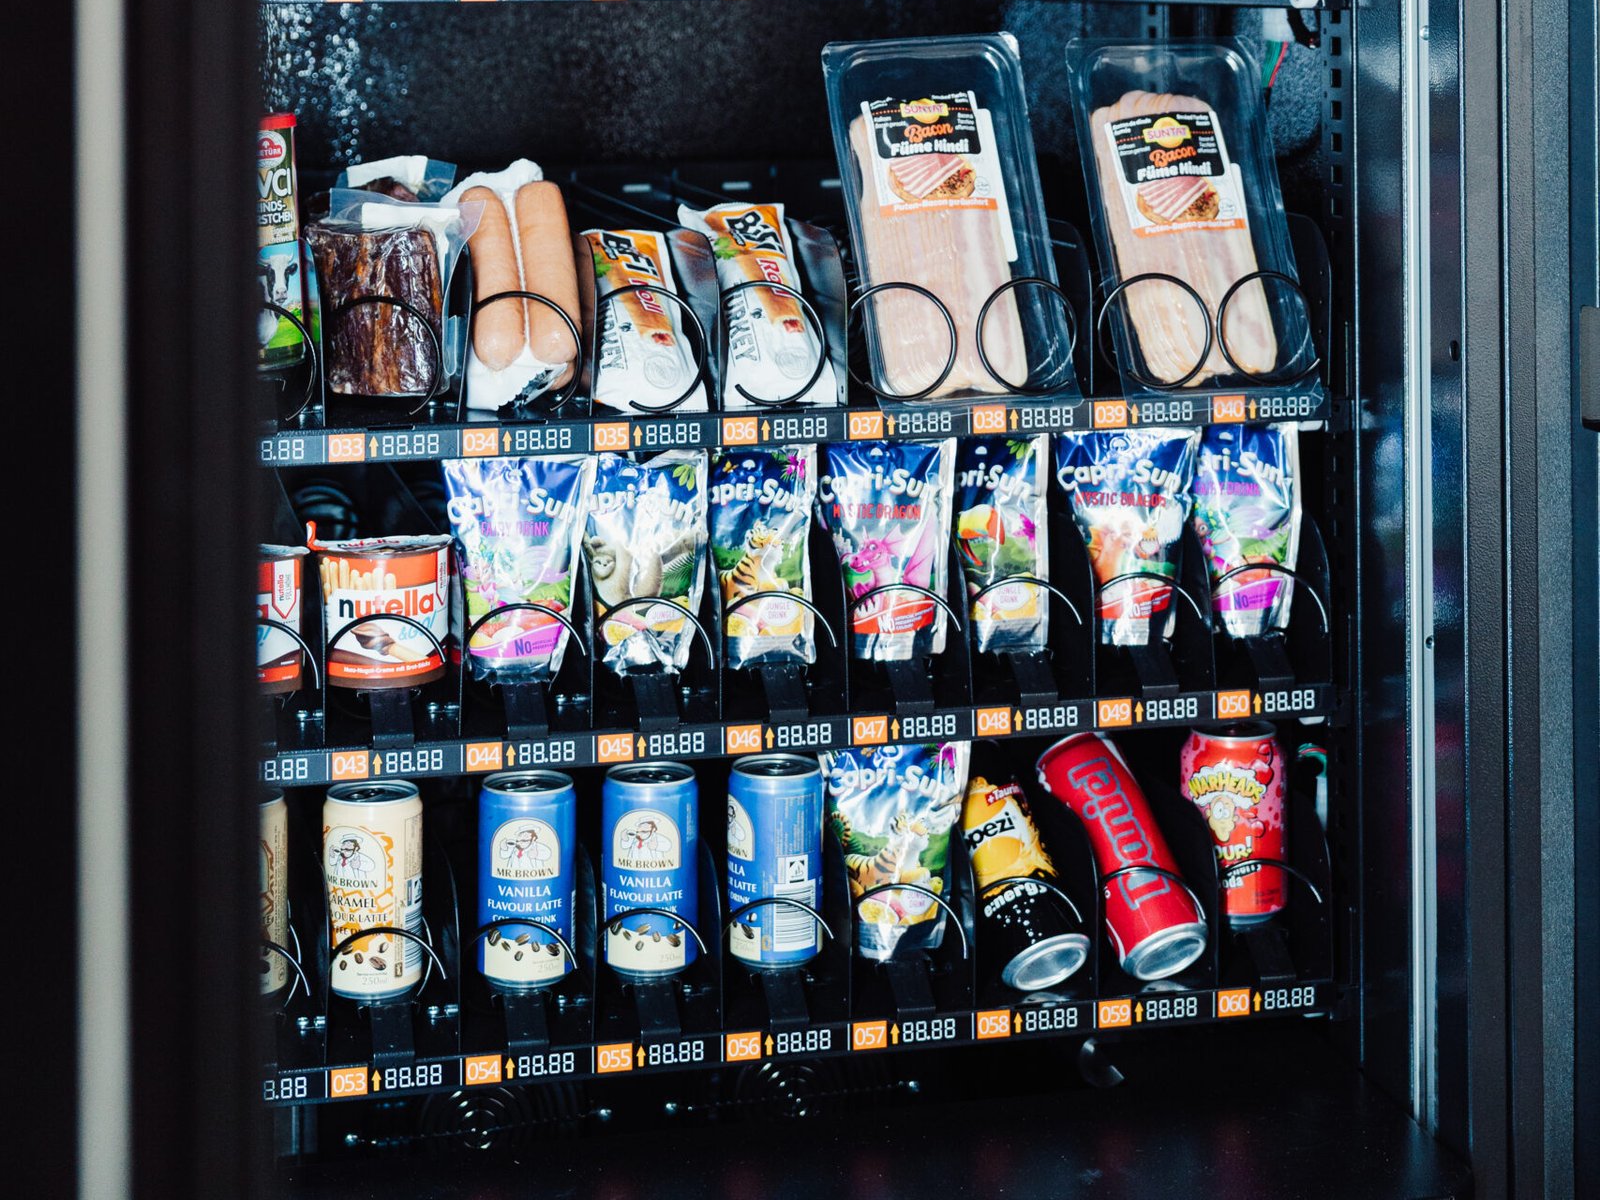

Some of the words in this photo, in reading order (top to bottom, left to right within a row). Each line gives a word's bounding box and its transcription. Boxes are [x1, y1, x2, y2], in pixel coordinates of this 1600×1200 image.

[904, 123, 954, 143] Bacon
[891, 142, 932, 156] Füme
[934, 139, 969, 153] Hindi
[1149, 146, 1197, 168] Bacon
[1137, 165, 1178, 181] Füme
[1179, 161, 1212, 175] Hindi
[974, 409, 1005, 429] 038
[1021, 407, 1073, 428] 88.88
[1095, 405, 1126, 423] 039
[1141, 402, 1193, 422] 88.88
[1212, 400, 1245, 418] 040
[1259, 397, 1310, 416] 88.88
[595, 427, 628, 446] 035
[646, 423, 700, 445] 88.88
[723, 422, 756, 440] 036
[774, 417, 827, 439] 88.88
[850, 416, 881, 435] 037
[899, 413, 952, 434] 88.88
[329, 436, 364, 458] 033
[383, 434, 439, 456] 88.88
[463, 432, 497, 451] 034
[516, 428, 571, 450] 88.88
[1057, 458, 1182, 494] Capri-Sun
[876, 503, 921, 520] DRAGON
[339, 589, 434, 619] nutella
[1100, 703, 1130, 722] 049
[1147, 698, 1197, 720] 88.88
[1219, 695, 1249, 713] 050
[1265, 690, 1315, 712] 88.88
[854, 720, 886, 740] 047
[903, 715, 956, 738] 88.88
[978, 712, 1009, 730] 048
[1026, 706, 1078, 729] 88.88
[600, 738, 632, 757] 045
[650, 732, 704, 755] 88.88
[728, 729, 761, 748] 046
[778, 723, 831, 747] 88.88
[333, 755, 368, 775] 043
[386, 750, 442, 773] 88.88
[467, 747, 501, 766] 044
[519, 741, 575, 764] 88.88
[1188, 771, 1264, 804] WARHEADS
[966, 811, 1016, 849] pezi
[1067, 755, 1171, 911] Daniel
[498, 885, 551, 898] VANILLA
[619, 875, 672, 887] VANILLA
[330, 897, 376, 908] ARAMEL
[487, 899, 534, 912] FLAVOUR
[535, 899, 562, 912] LATTE
[610, 888, 658, 902] FLAVOUR
[658, 889, 683, 902] LATTE
[359, 913, 388, 922] LATTE
[1100, 1004, 1130, 1024] 059
[1147, 997, 1197, 1020] 88.88
[1219, 994, 1249, 1012] 060
[1265, 987, 1314, 1009] 88.88
[854, 1026, 885, 1046] 057
[903, 1018, 955, 1042] 88.88
[978, 1015, 1009, 1035] 058
[1026, 1008, 1077, 1031] 88.88
[599, 1049, 631, 1068] 055
[649, 1041, 704, 1065] 88.88
[728, 1037, 760, 1057] 056
[777, 1029, 831, 1053] 88.88
[333, 1073, 366, 1093] 053
[385, 1064, 441, 1089] 88.88
[467, 1061, 500, 1081] 054
[519, 1052, 574, 1076] 88.88
